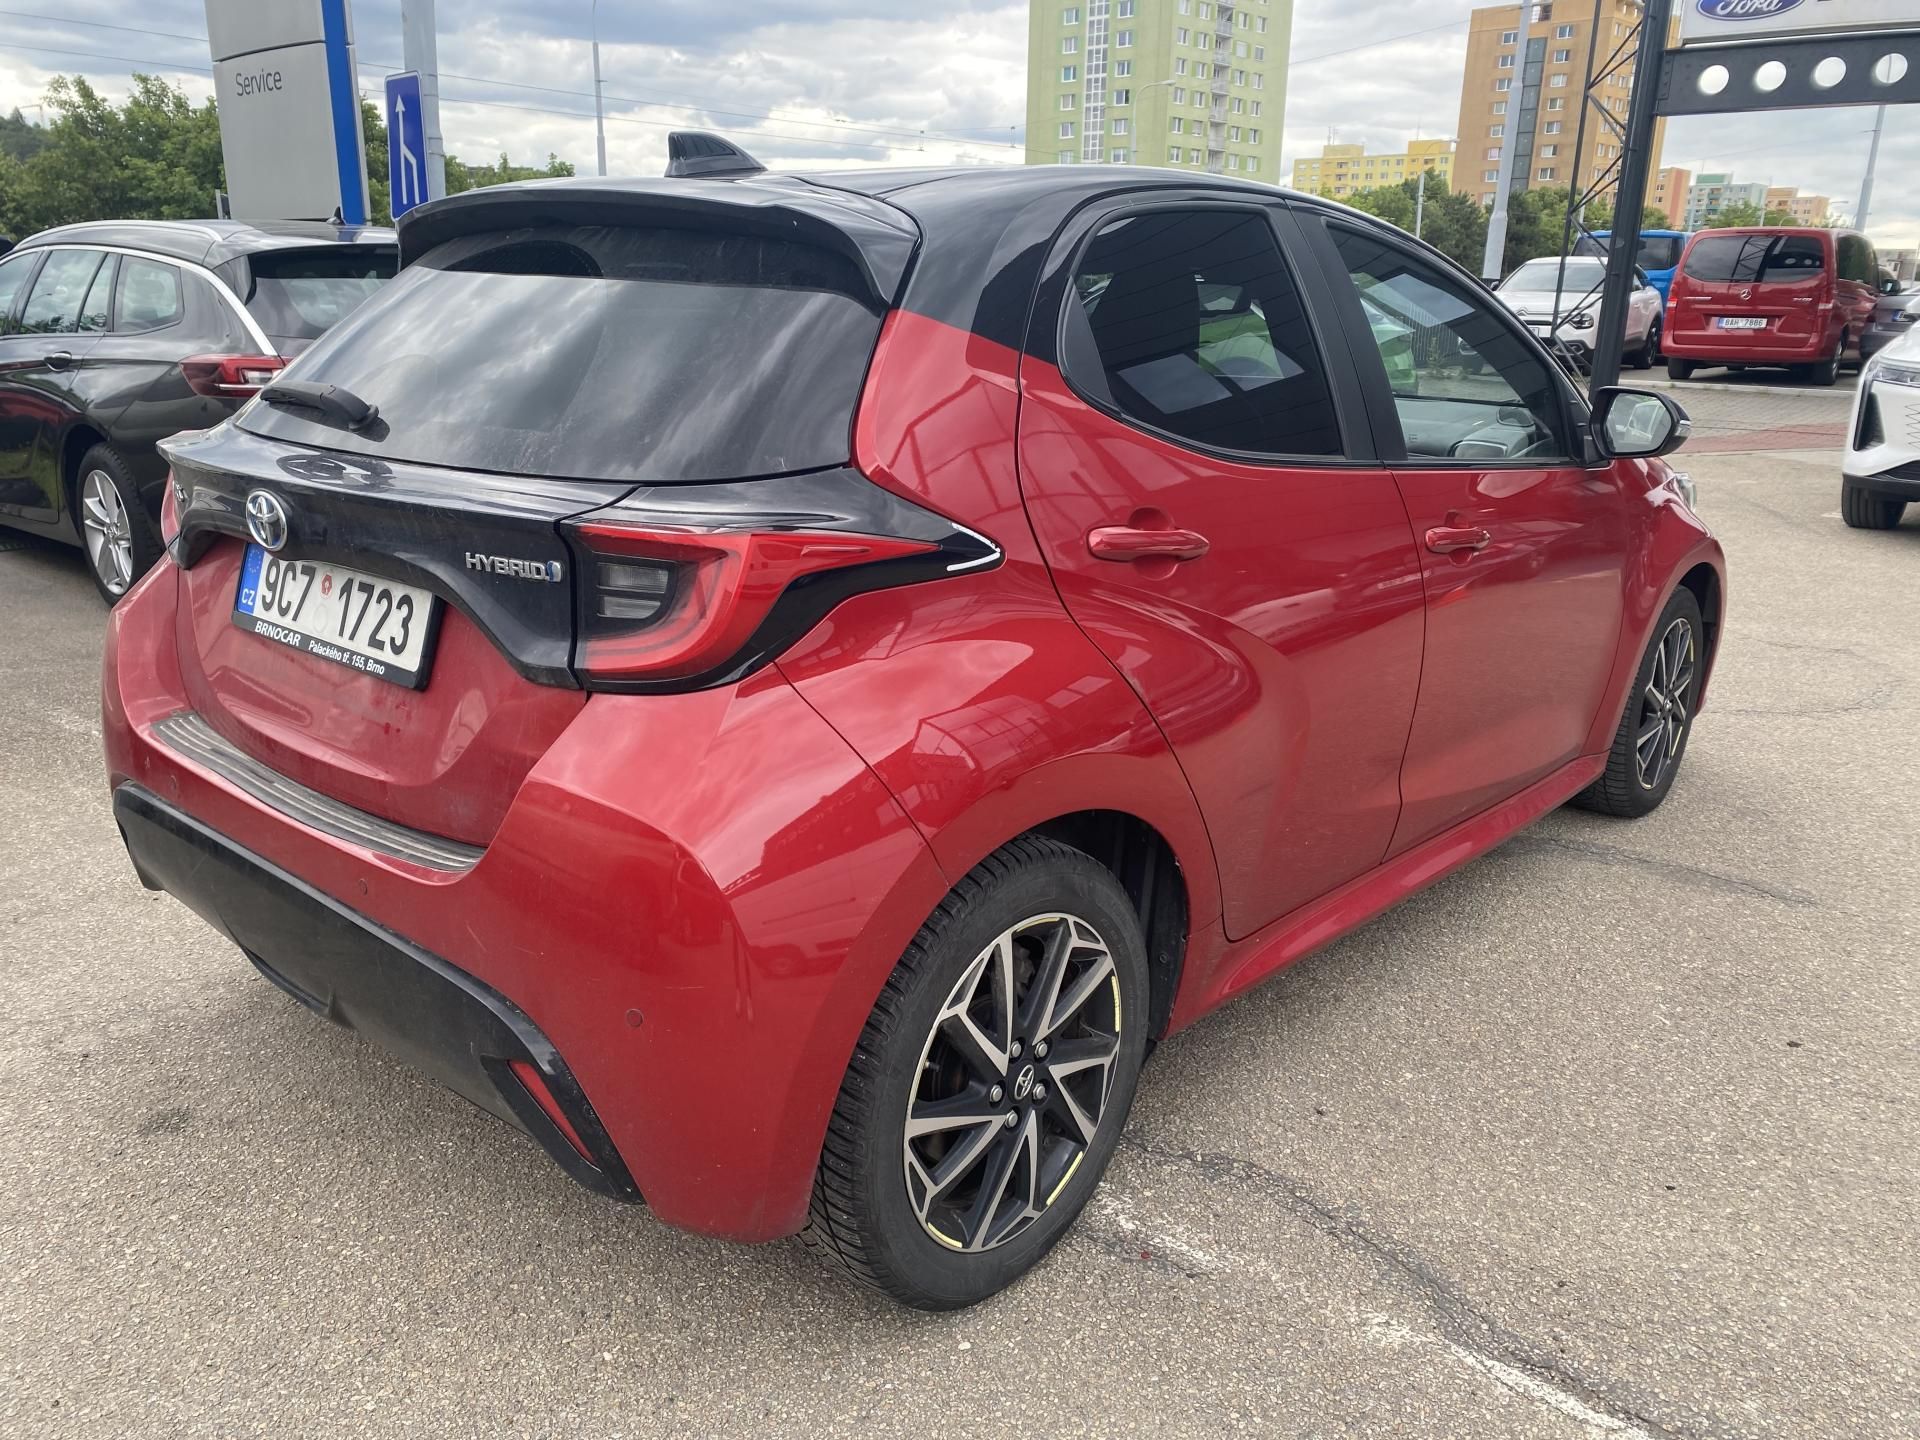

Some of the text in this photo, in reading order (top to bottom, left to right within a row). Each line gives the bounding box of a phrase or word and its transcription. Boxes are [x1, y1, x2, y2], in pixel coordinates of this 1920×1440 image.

[235, 68, 283, 96] Service
[465, 551, 545, 580] HYBRID
[241, 588, 256, 606] CZ
[261, 558, 414, 655] 9C7 1723
[254, 620, 301, 647] BRNOCAR
[308, 640, 342, 661] Palackého
[351, 654, 365, 671] 155,
[366, 659, 385, 675] Brno
